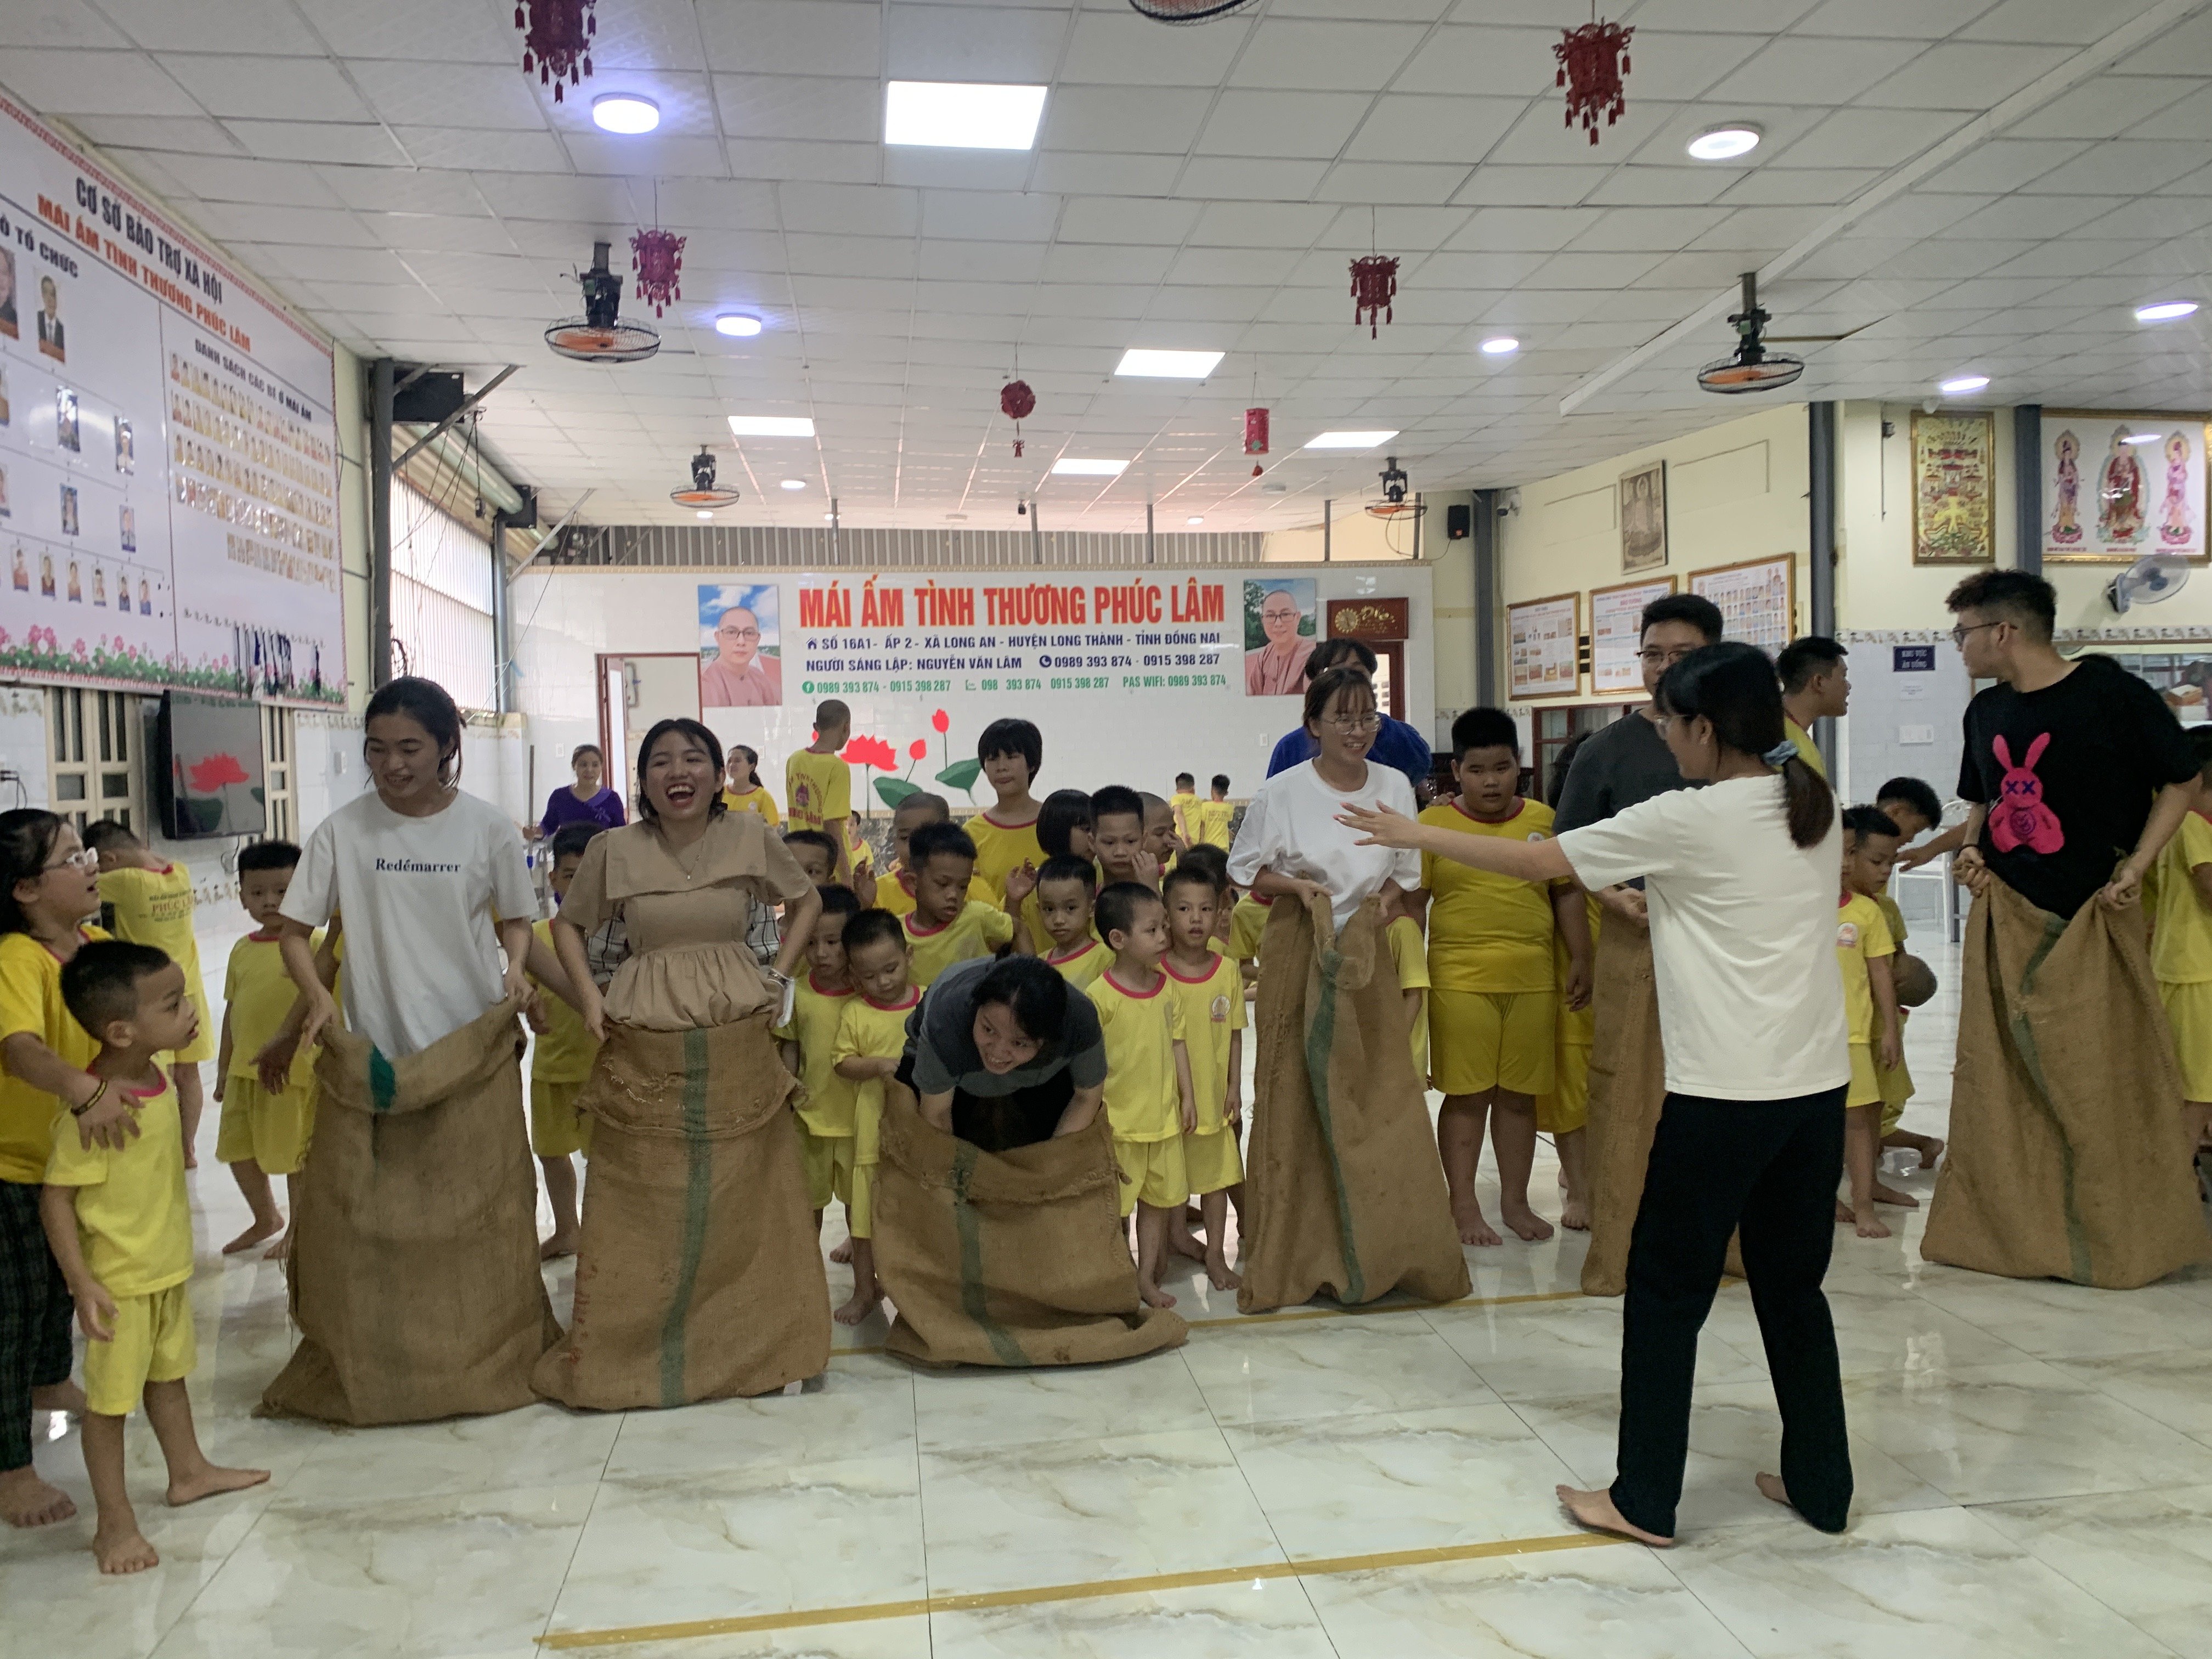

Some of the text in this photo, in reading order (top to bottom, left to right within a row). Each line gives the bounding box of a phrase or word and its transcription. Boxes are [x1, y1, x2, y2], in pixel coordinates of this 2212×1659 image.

[202, 270, 222, 304] HỘI
[799, 574, 1224, 628] MÁI ẤM TÌNH THƯƠNG PHÚC LÂM
[822, 634, 838, 650] SỐ
[924, 634, 940, 648] XÃ
[944, 636, 975, 648] LONG
[979, 636, 996, 648] AN
[1008, 633, 1047, 650] HUYỆN
[1051, 635, 1081, 647] LONG
[1085, 631, 1123, 646] THÀNH
[1135, 629, 1161, 645] TỈNH
[1200, 633, 1220, 644] NAI
[806, 657, 844, 672] NGƯỜI
[849, 657, 882, 671] SÁNG
[917, 653, 965, 670] NGUYỄN
[969, 655, 992, 669] VĂN
[997, 654, 1022, 669] LÂM
[1054, 656, 1083, 668] 0989
[1086, 656, 1108, 667] 393
[1111, 656, 1132, 667] 874
[1144, 654, 1171, 666] 0915
[1175, 654, 1195, 665] 398
[1199, 653, 1220, 665] 287
[817, 681, 840, 694] 0989
[842, 681, 860, 693] 393
[862, 681, 879, 693] 874
[890, 680, 912, 692] 0915
[915, 680, 932, 692] 398
[934, 680, 951, 691] 287
[1006, 679, 1022, 690] 393
[1025, 679, 1042, 690] 874
[1051, 677, 1072, 689] 0915
[1075, 677, 1091, 689] 398
[1093, 677, 1109, 689] 287
[1123, 675, 1141, 687] PAS
[1168, 675, 1189, 686] 0989
[1192, 675, 1207, 686] 393
[1210, 674, 1226, 686] 874
[375, 857, 461, 872] Redémarrer
